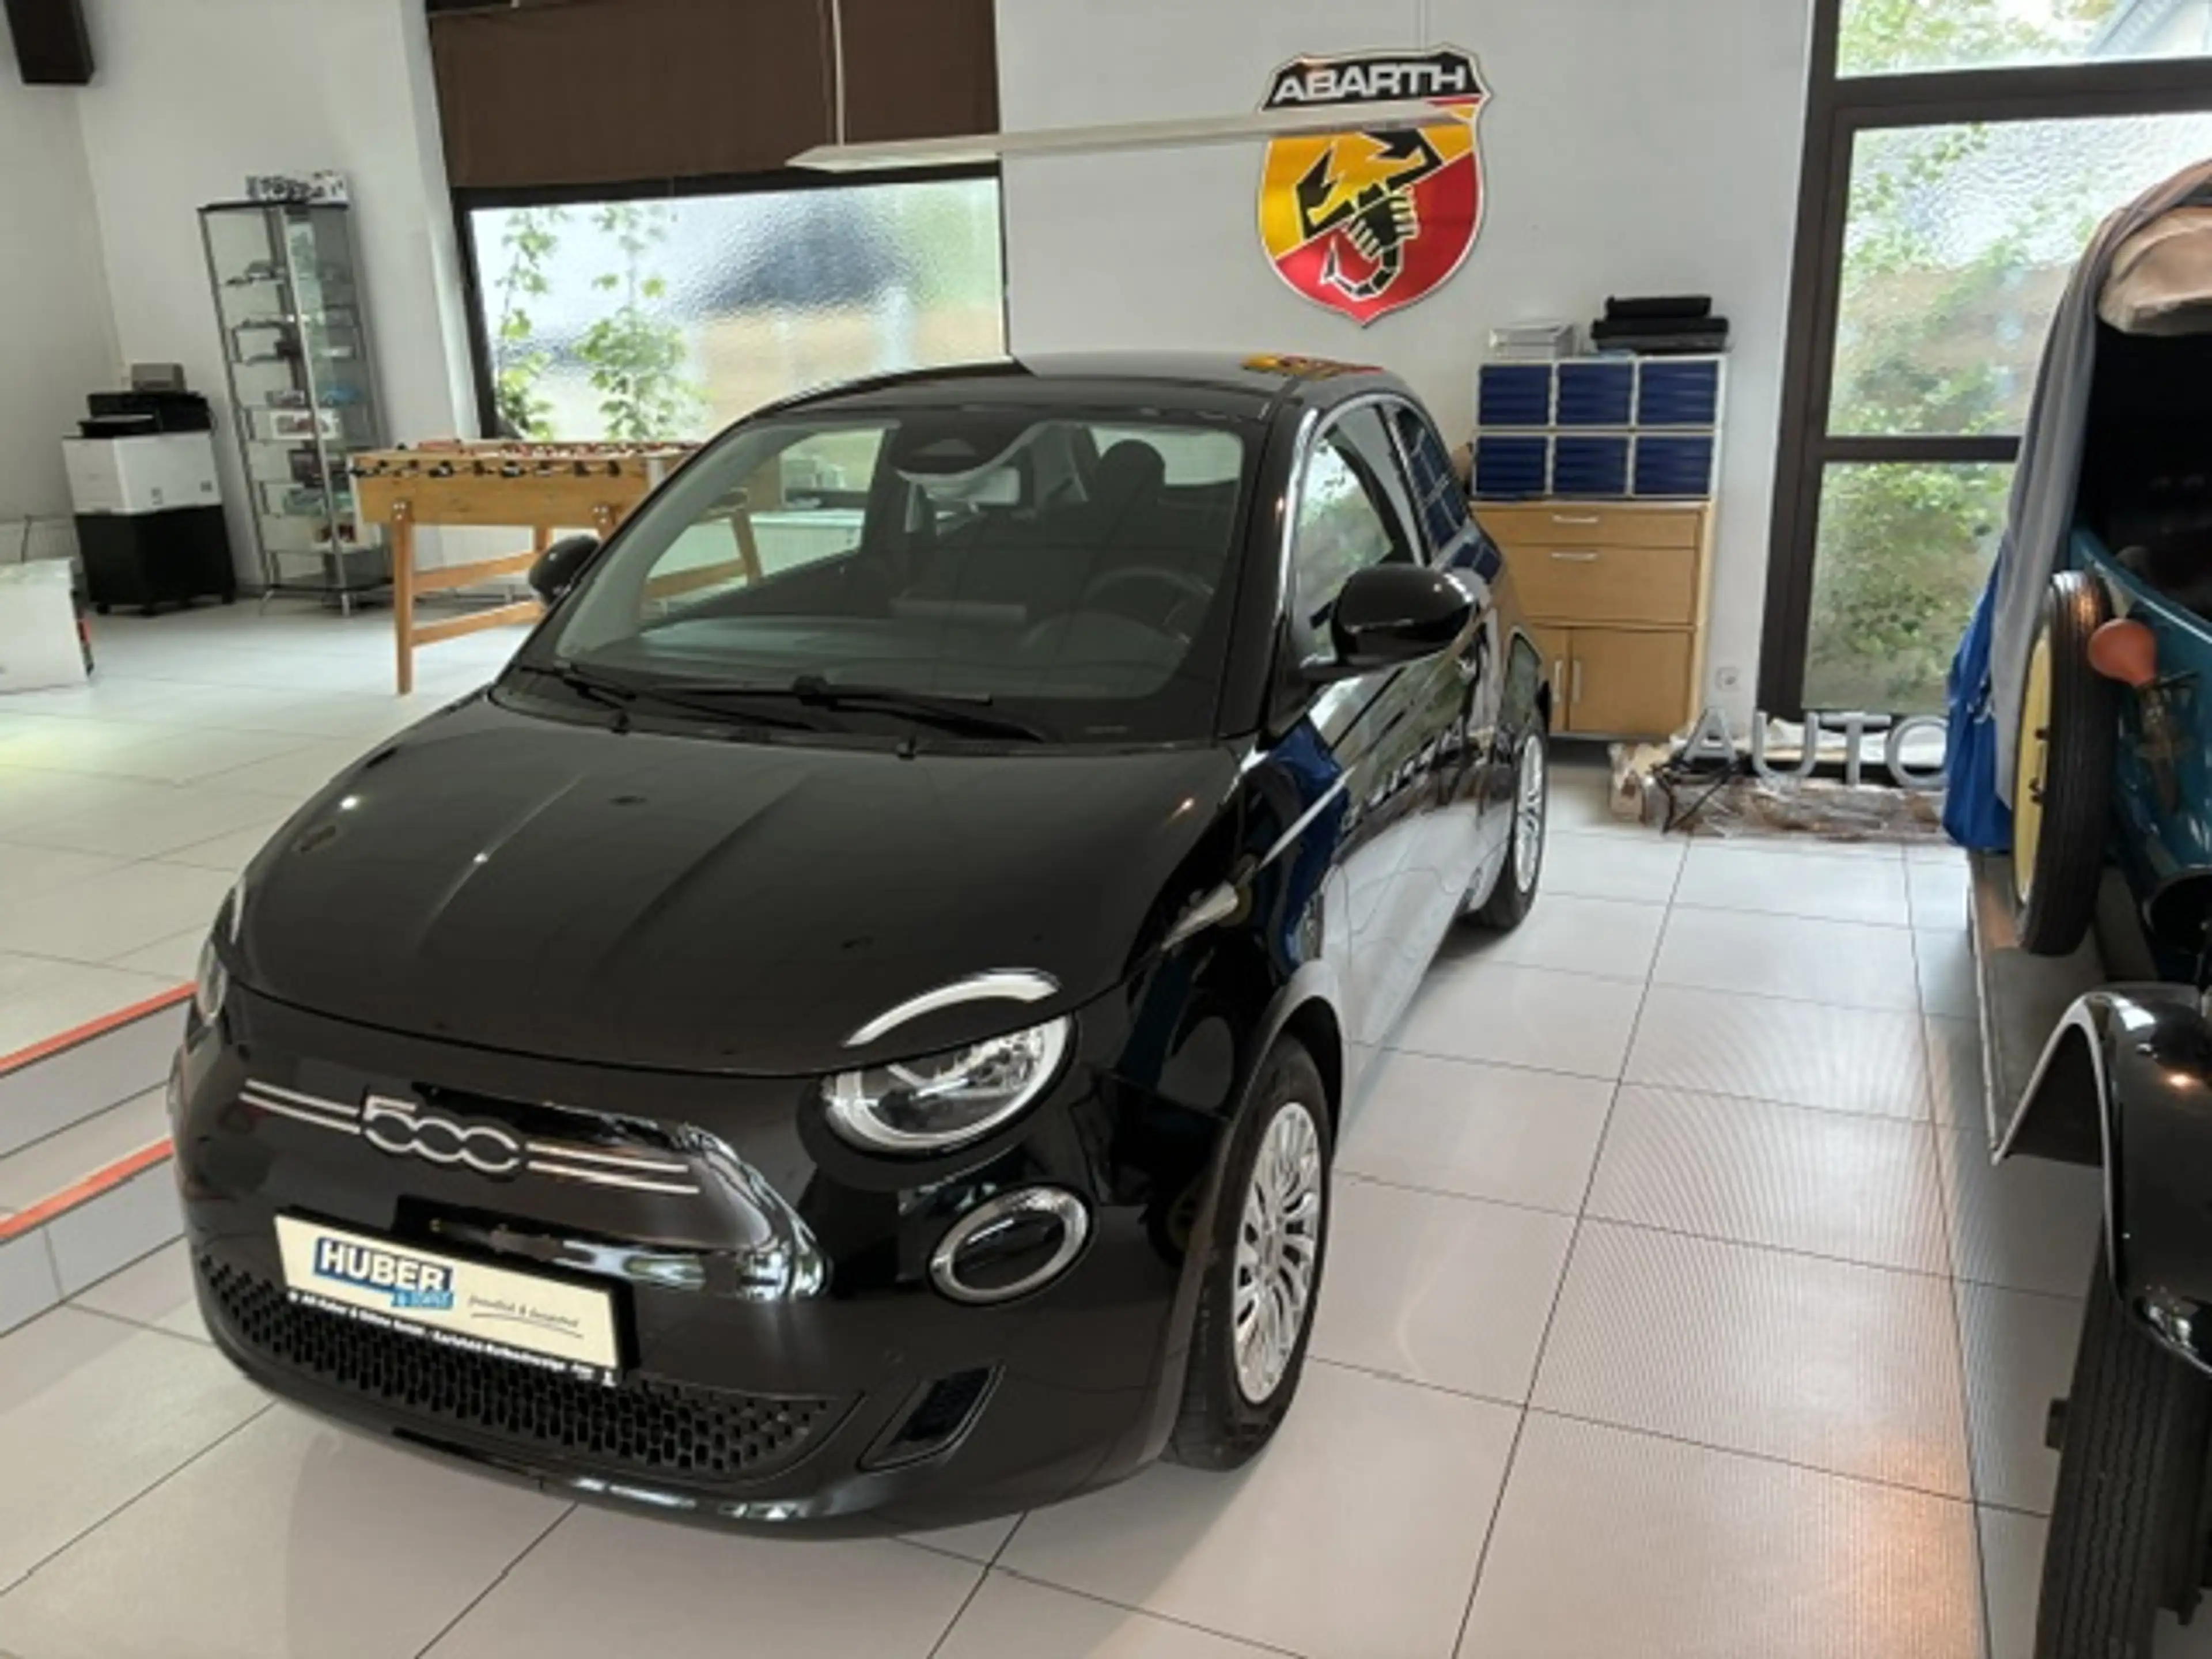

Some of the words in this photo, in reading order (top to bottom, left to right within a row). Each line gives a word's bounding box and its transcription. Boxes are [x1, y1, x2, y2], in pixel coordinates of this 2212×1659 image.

[1272, 62, 1465, 104] ABARTH
[363, 1094, 519, 1172] 500
[320, 1240, 444, 1291] HUBER
